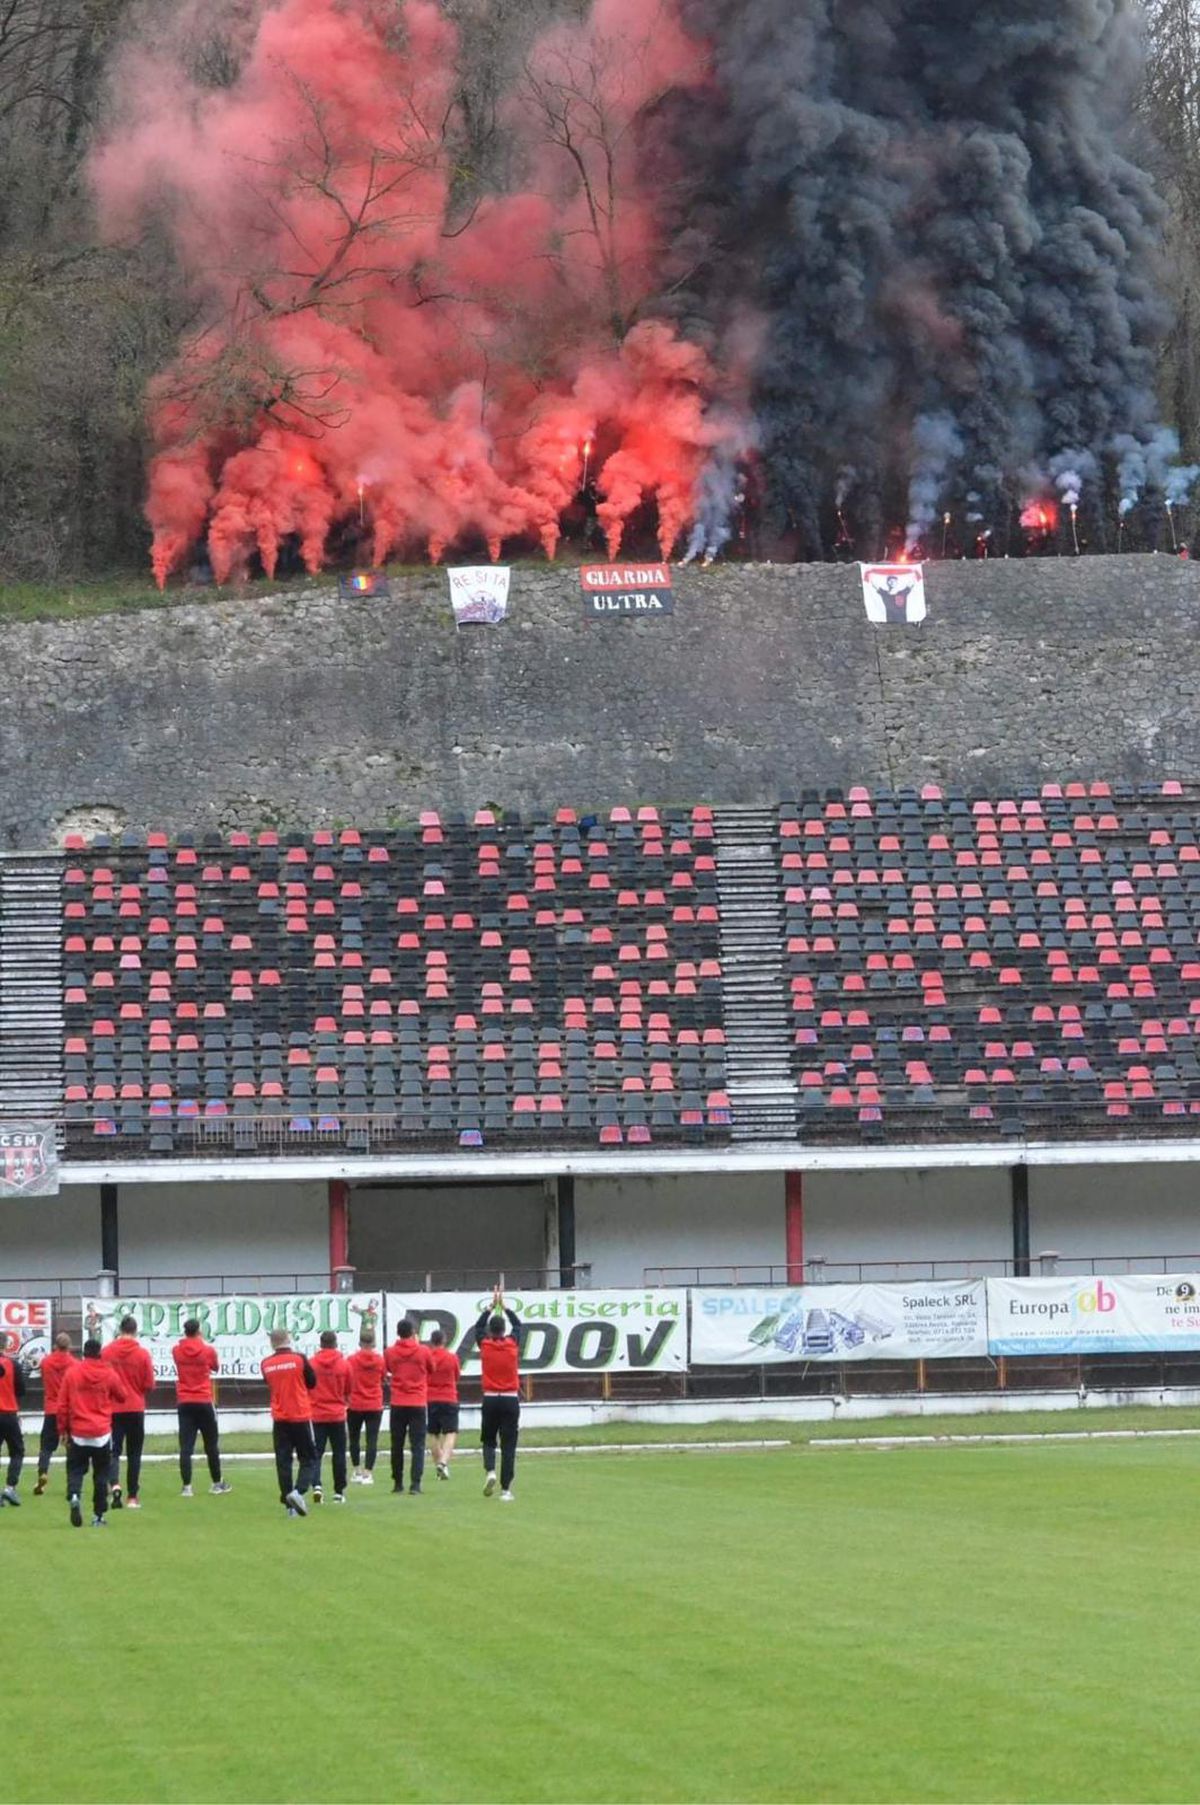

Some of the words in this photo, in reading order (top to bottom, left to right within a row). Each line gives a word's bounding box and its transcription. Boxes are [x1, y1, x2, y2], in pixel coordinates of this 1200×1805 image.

[586, 569, 665, 585] GUARDIA
[593, 593, 663, 610] ULTRA
[1, 1135, 37, 1146] CSM
[1156, 1286, 1173, 1296] De
[477, 1295, 680, 1318] Patiseria
[903, 1296, 950, 1310] Spaleck
[955, 1294, 978, 1306] SRL
[1010, 1299, 1069, 1320] Europa
[1165, 1306, 1180, 1314] ne
